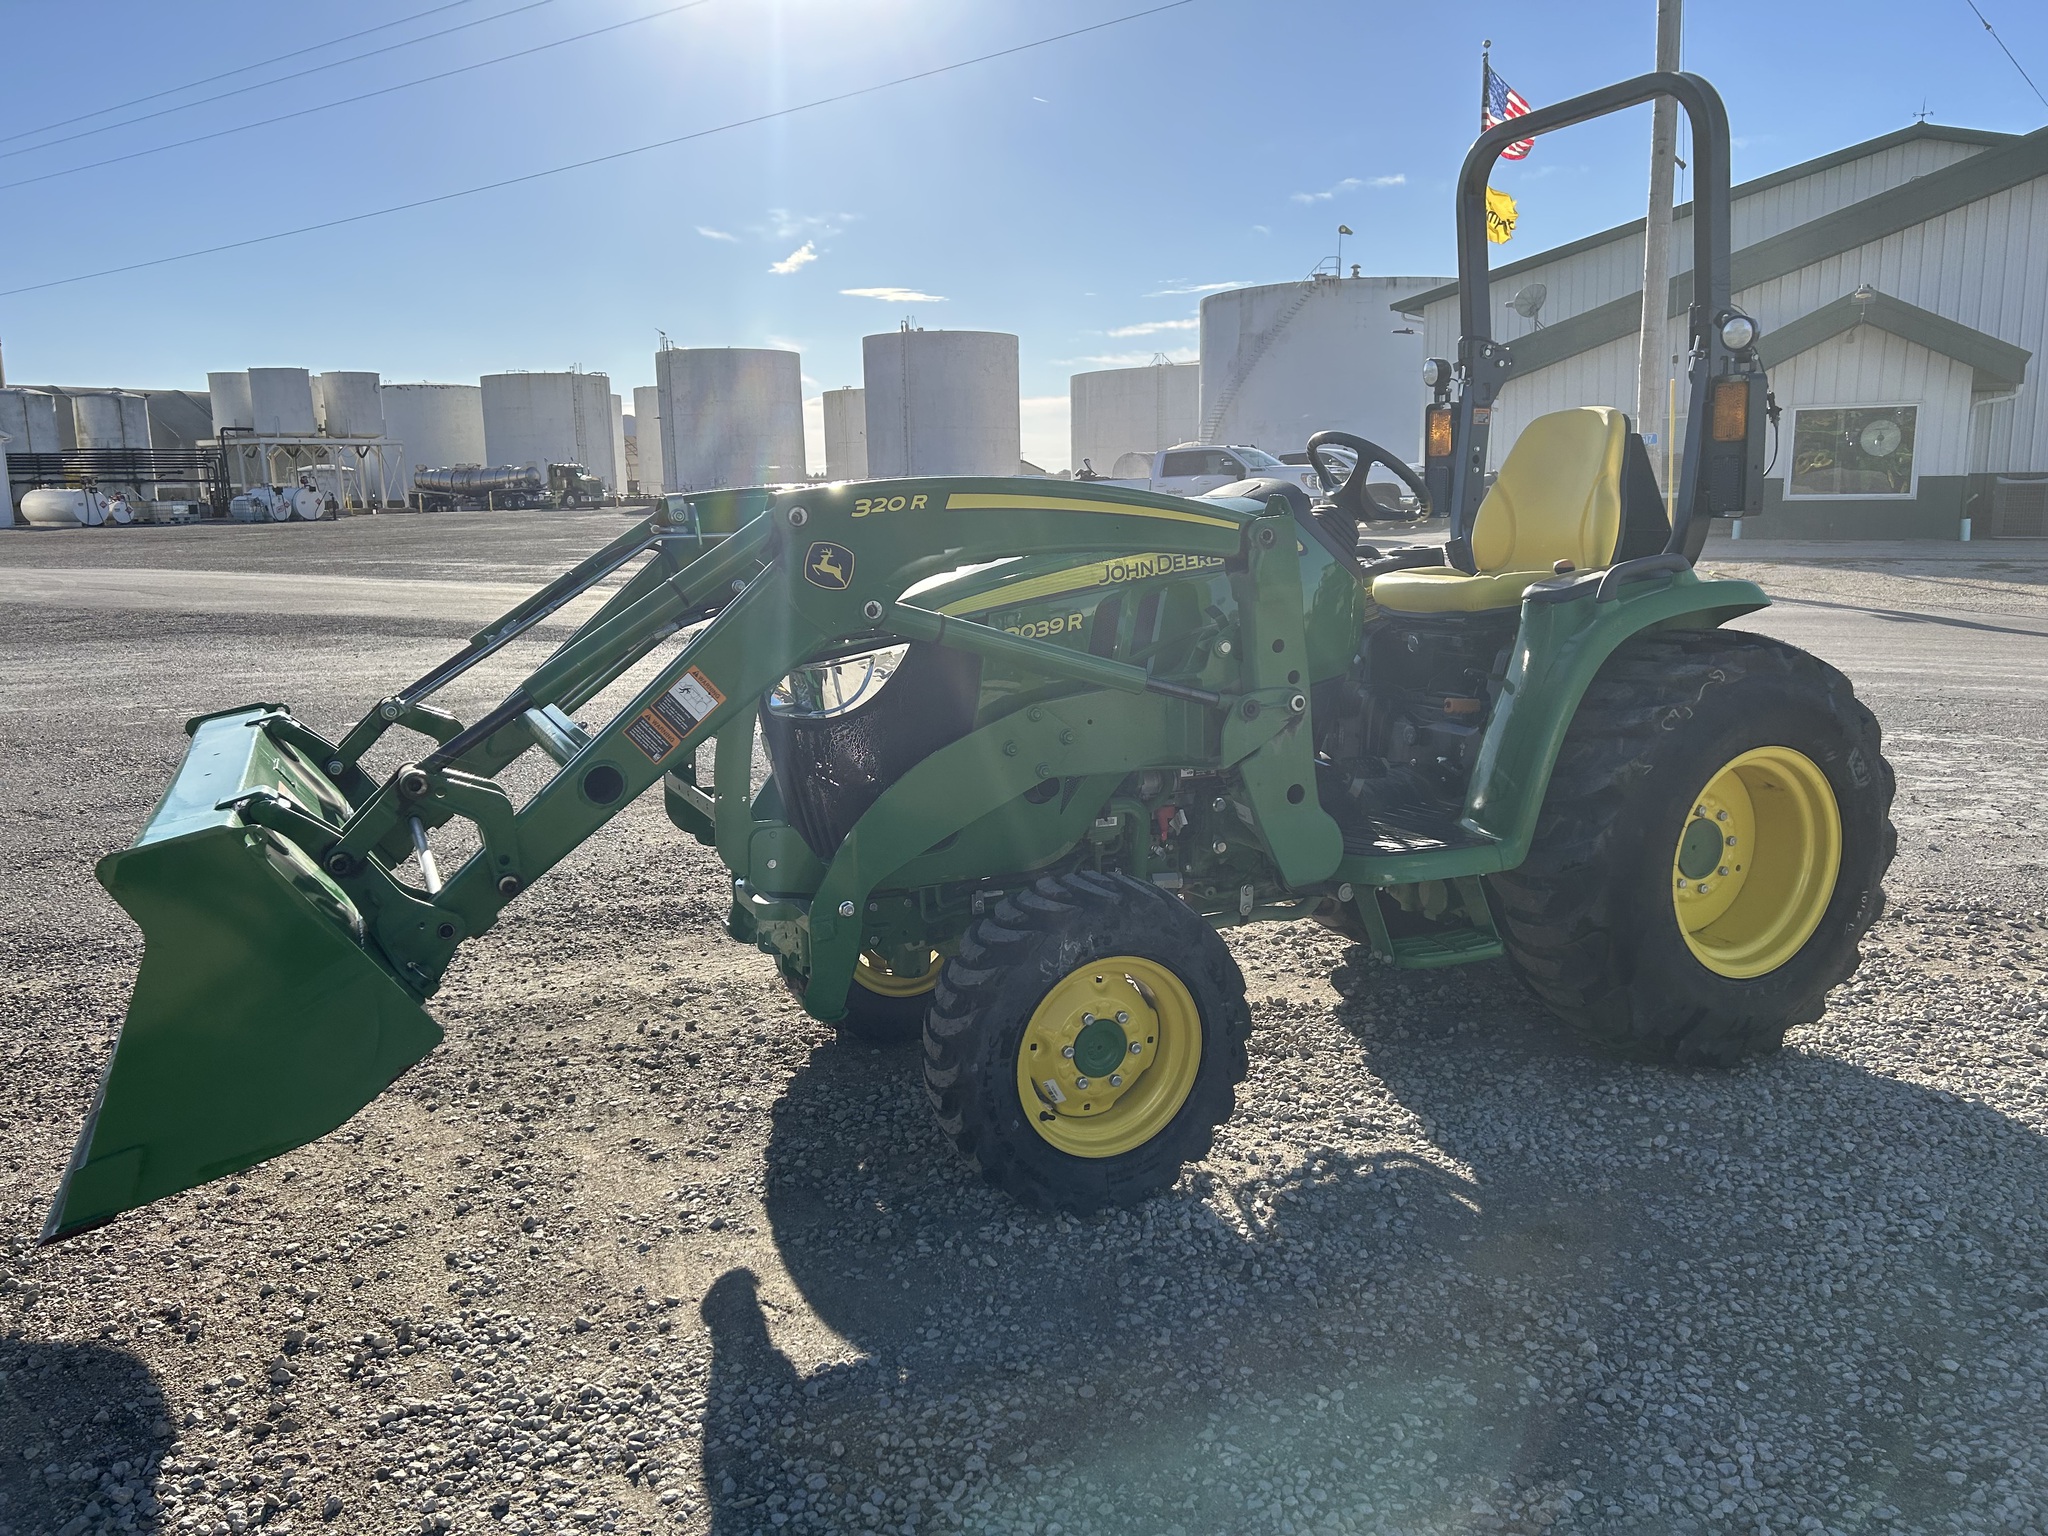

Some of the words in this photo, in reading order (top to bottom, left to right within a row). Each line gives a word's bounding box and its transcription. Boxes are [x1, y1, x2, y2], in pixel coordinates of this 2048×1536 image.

[851, 496, 906, 518] 320
[910, 494, 928, 510] R
[1098, 560, 1154, 583] JOHN
[1067, 613, 1083, 632] R
[698, 675, 721, 700] WARNING
[651, 719, 675, 743] WARNING
